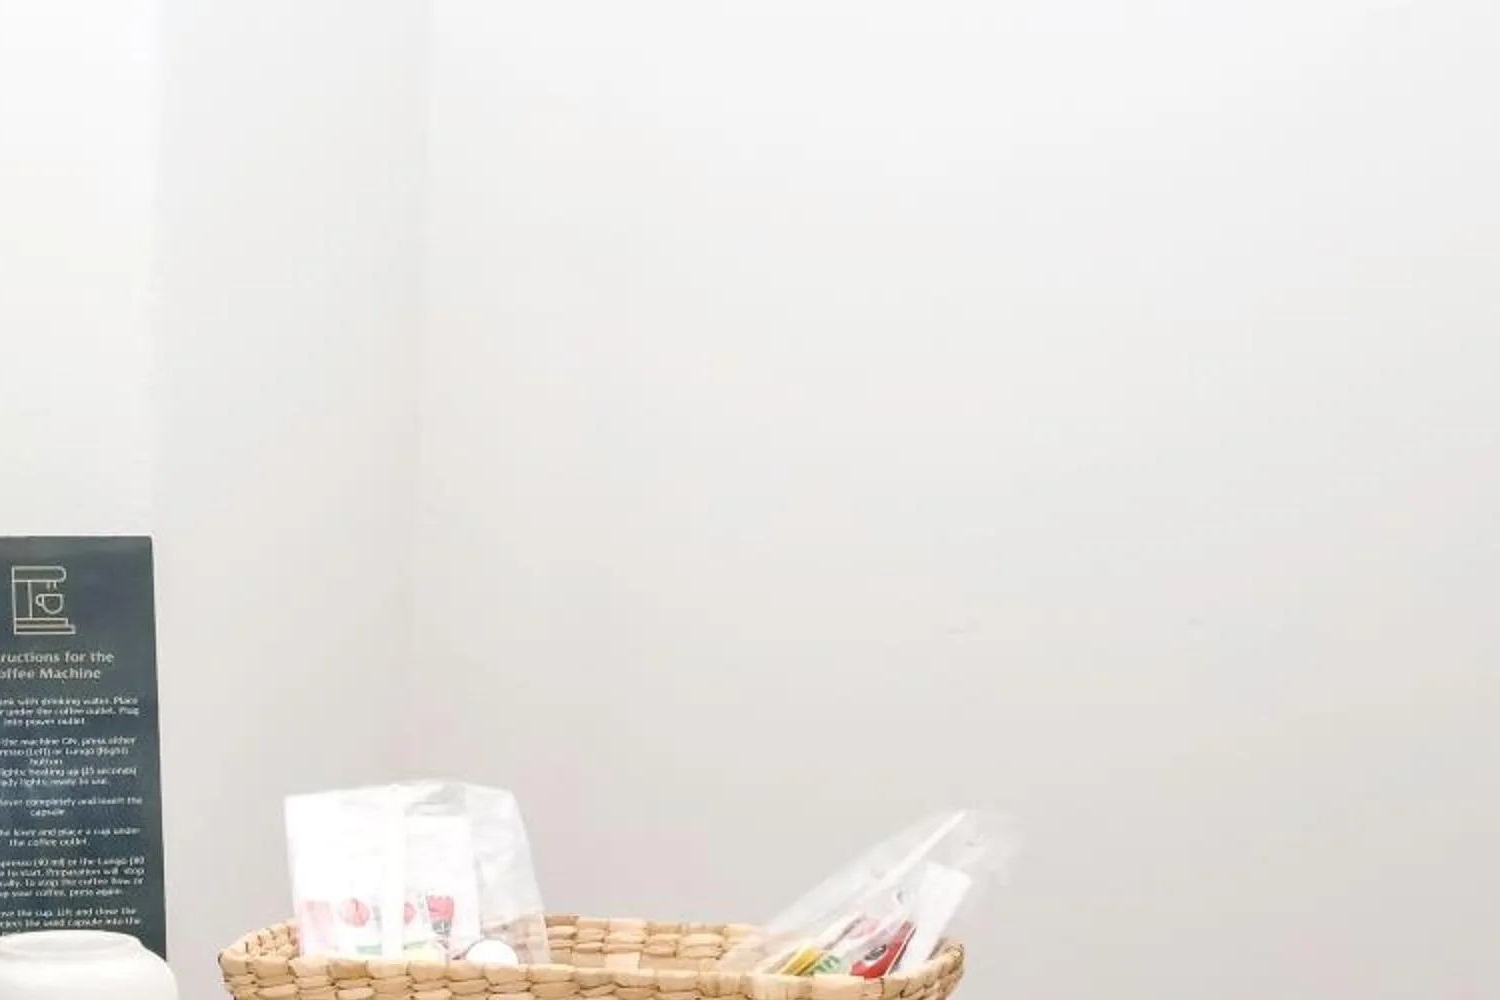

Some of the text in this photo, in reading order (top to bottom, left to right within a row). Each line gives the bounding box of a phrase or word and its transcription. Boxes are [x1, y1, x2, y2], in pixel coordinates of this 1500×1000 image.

[64, 651, 87, 664] for
[89, 651, 115, 664] the
[39, 668, 101, 680] Machine
